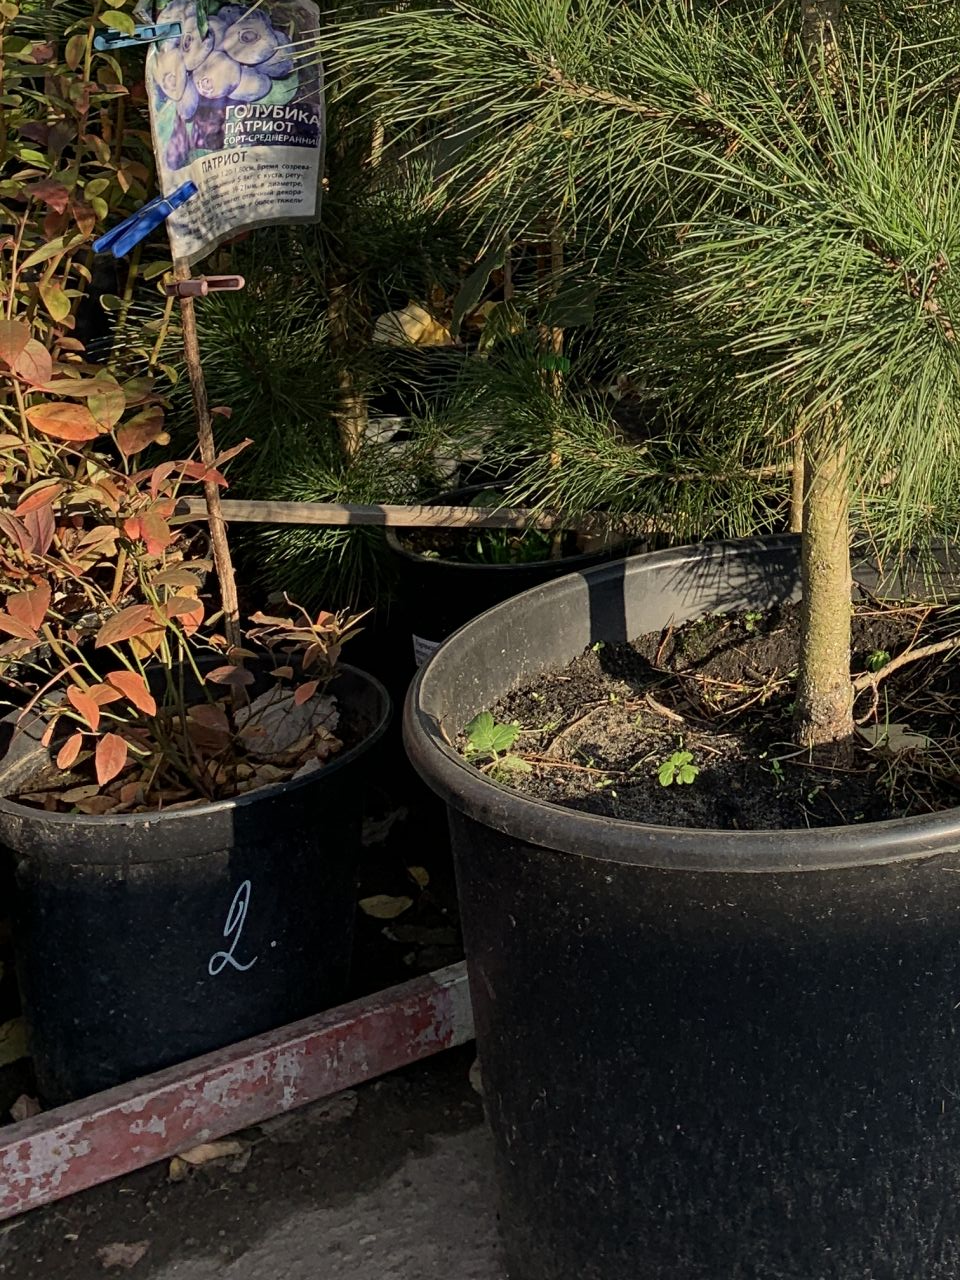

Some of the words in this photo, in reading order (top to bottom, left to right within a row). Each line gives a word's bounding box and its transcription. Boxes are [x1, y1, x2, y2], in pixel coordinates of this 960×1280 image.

[225, 104, 319, 126] ГОЛУБИКА
[225, 119, 295, 135] ПАТРИОТ
[202, 151, 248, 173] ПАТРИОТ
